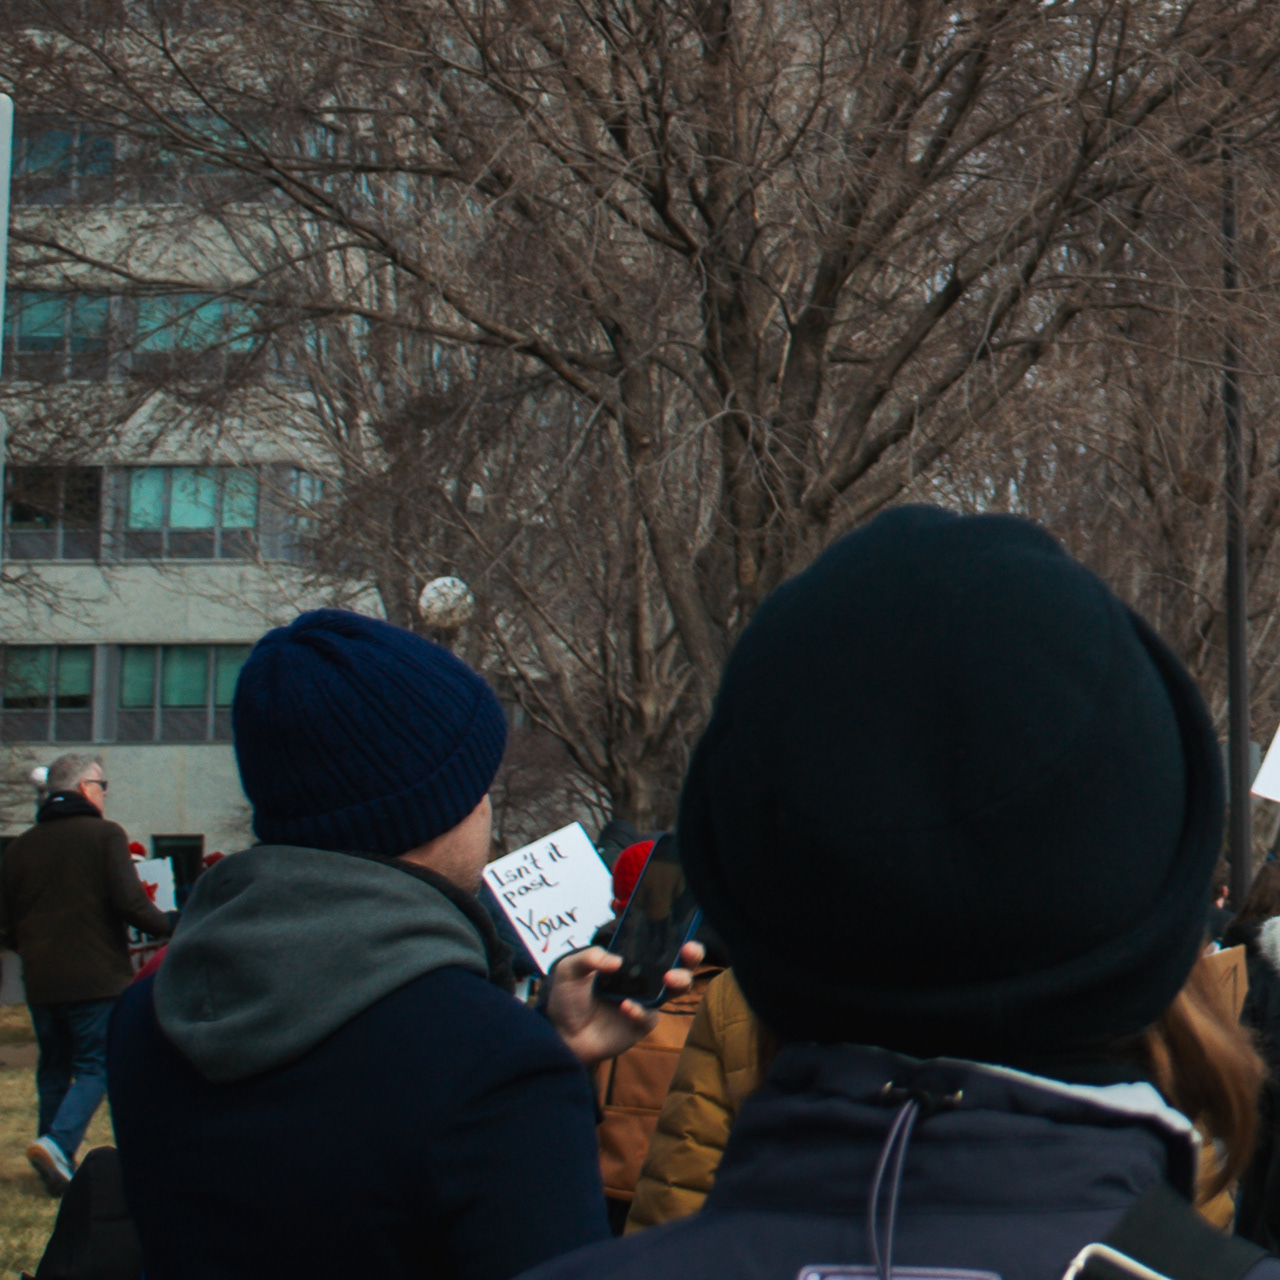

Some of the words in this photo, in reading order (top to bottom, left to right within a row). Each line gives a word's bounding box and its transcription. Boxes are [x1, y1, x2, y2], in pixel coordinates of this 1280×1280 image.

[488, 852, 543, 887] Isn't
[547, 842, 568, 862] it
[503, 874, 559, 908] past
[516, 906, 578, 941] Your
